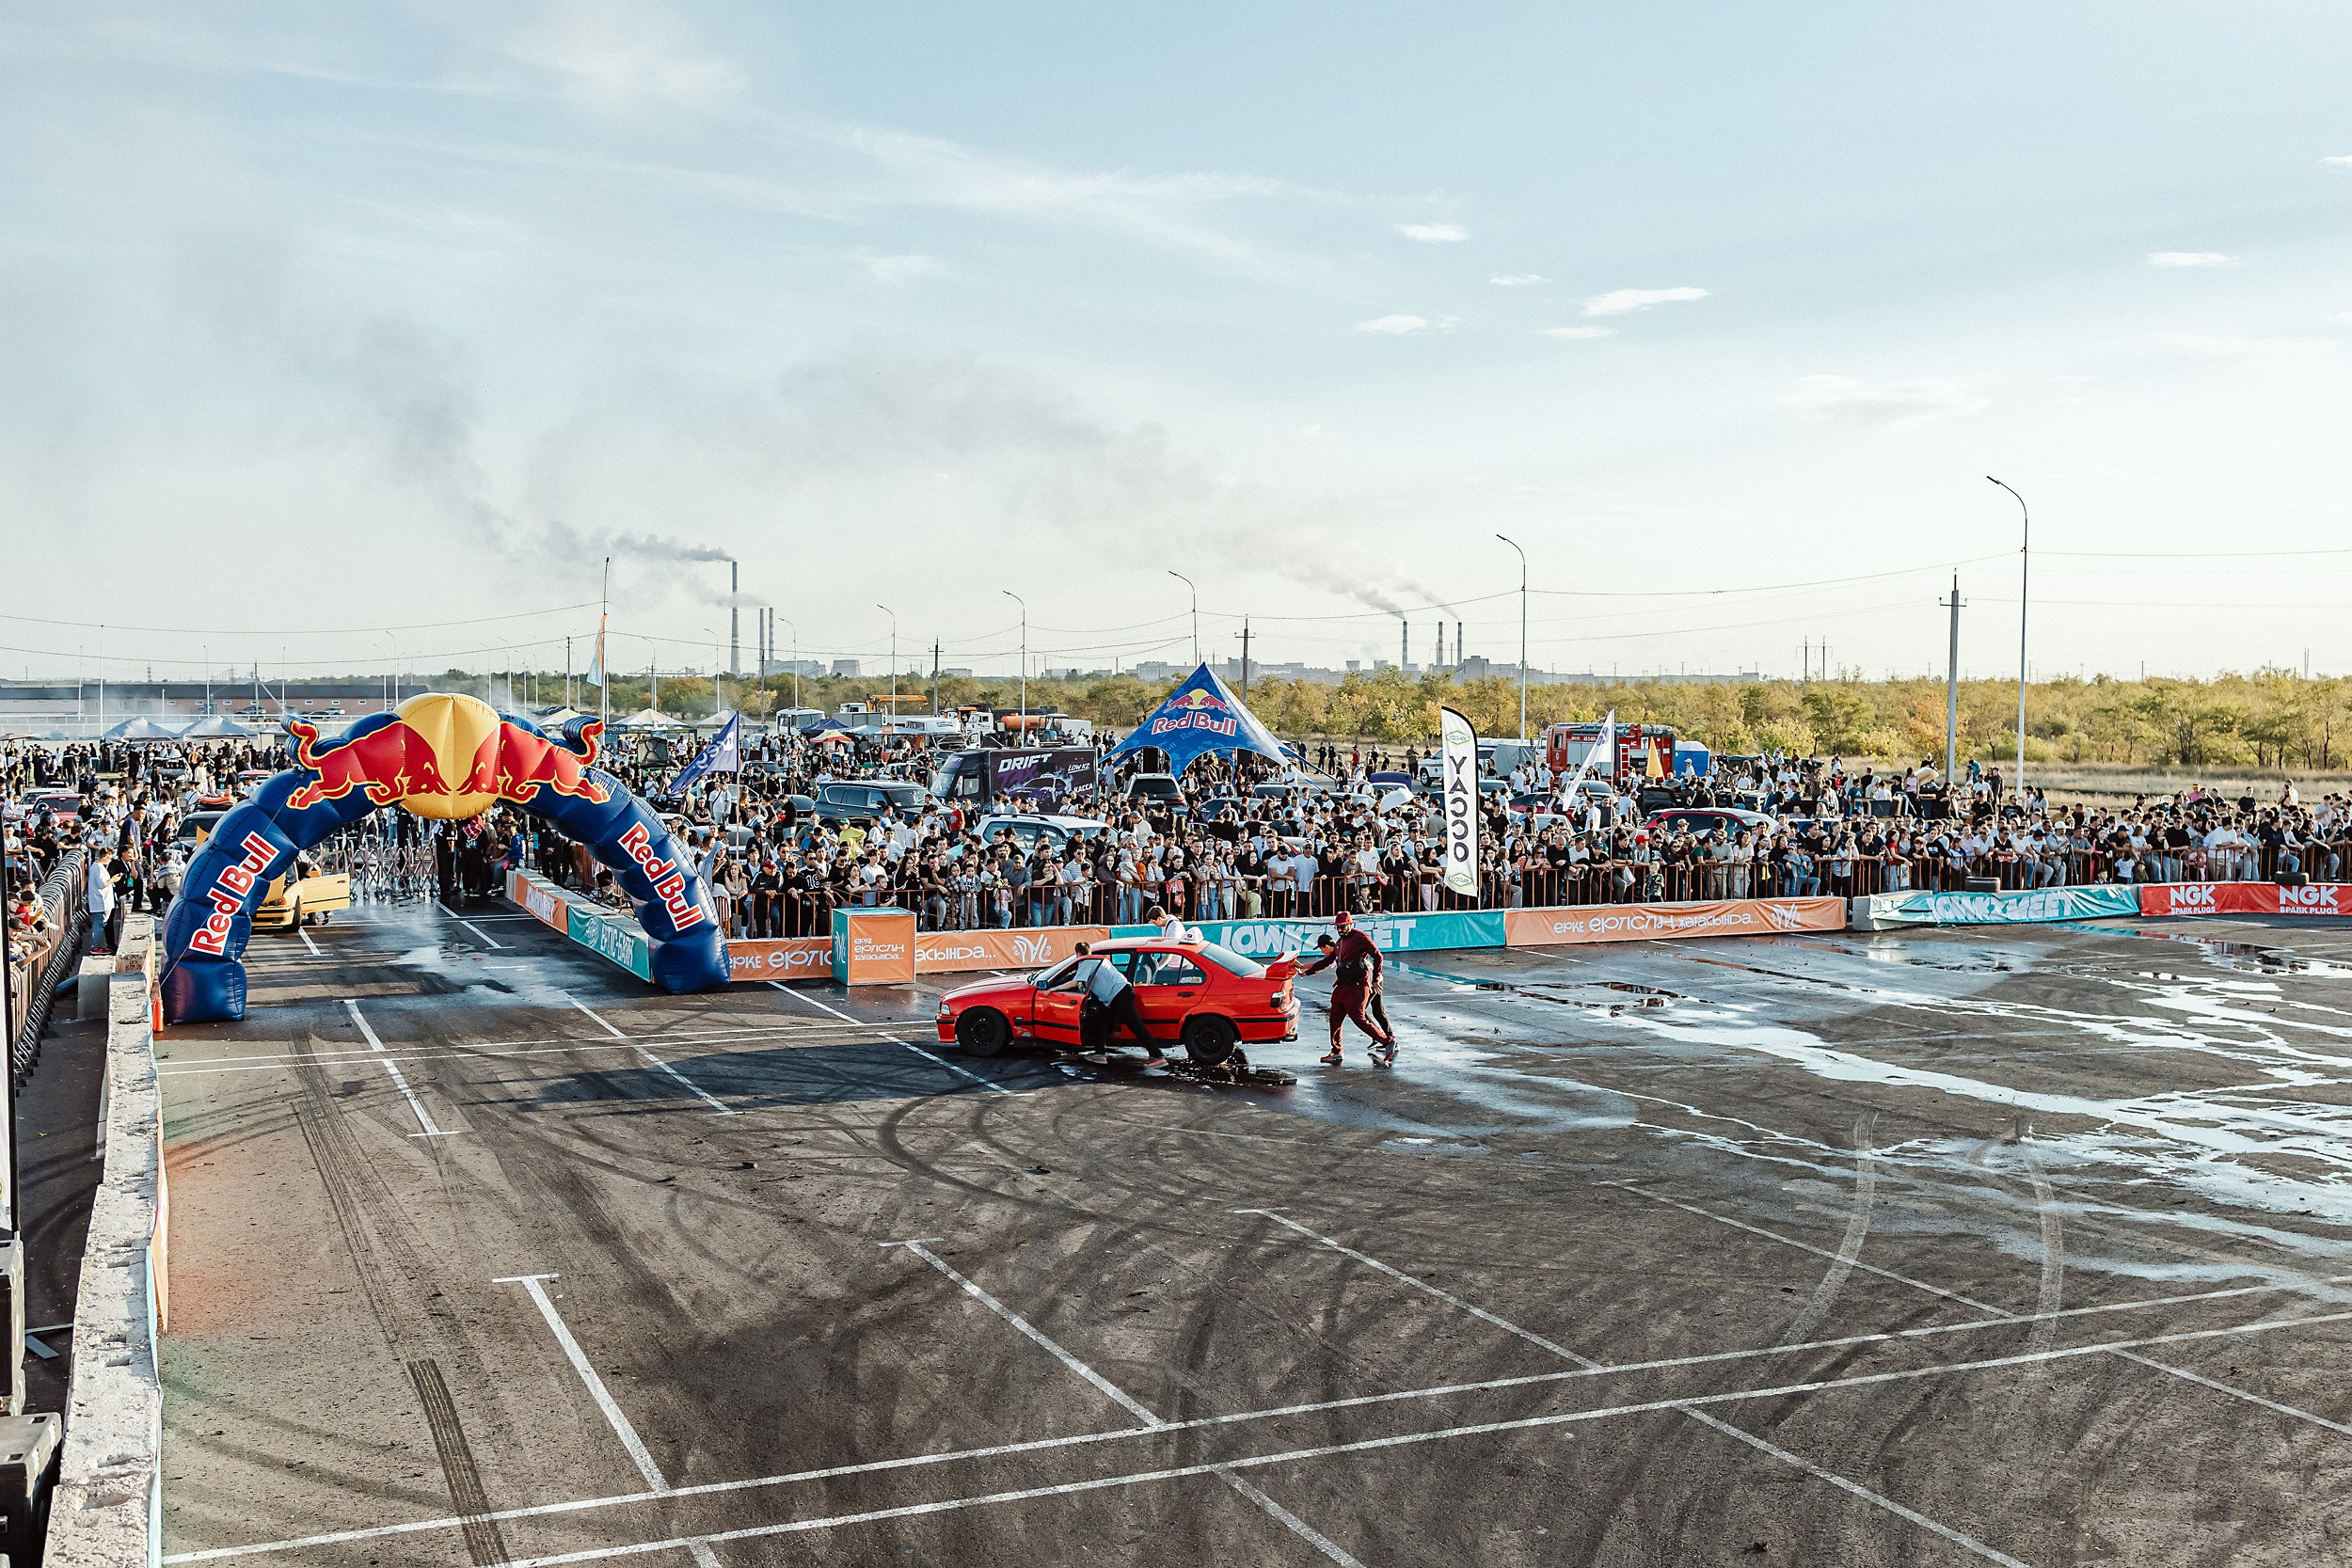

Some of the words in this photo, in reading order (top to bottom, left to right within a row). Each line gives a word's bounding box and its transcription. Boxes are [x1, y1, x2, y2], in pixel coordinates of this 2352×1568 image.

[1152, 711, 1193, 735] Red
[1193, 712, 1237, 736] Bull
[998, 753, 1052, 772] DRIFT
[618, 821, 676, 881] Red
[655, 872, 704, 930] Bull
[190, 888, 243, 955] Red
[217, 832, 279, 896] Bull
[2169, 884, 2216, 906] NGK
[2280, 885, 2339, 906] NGK
